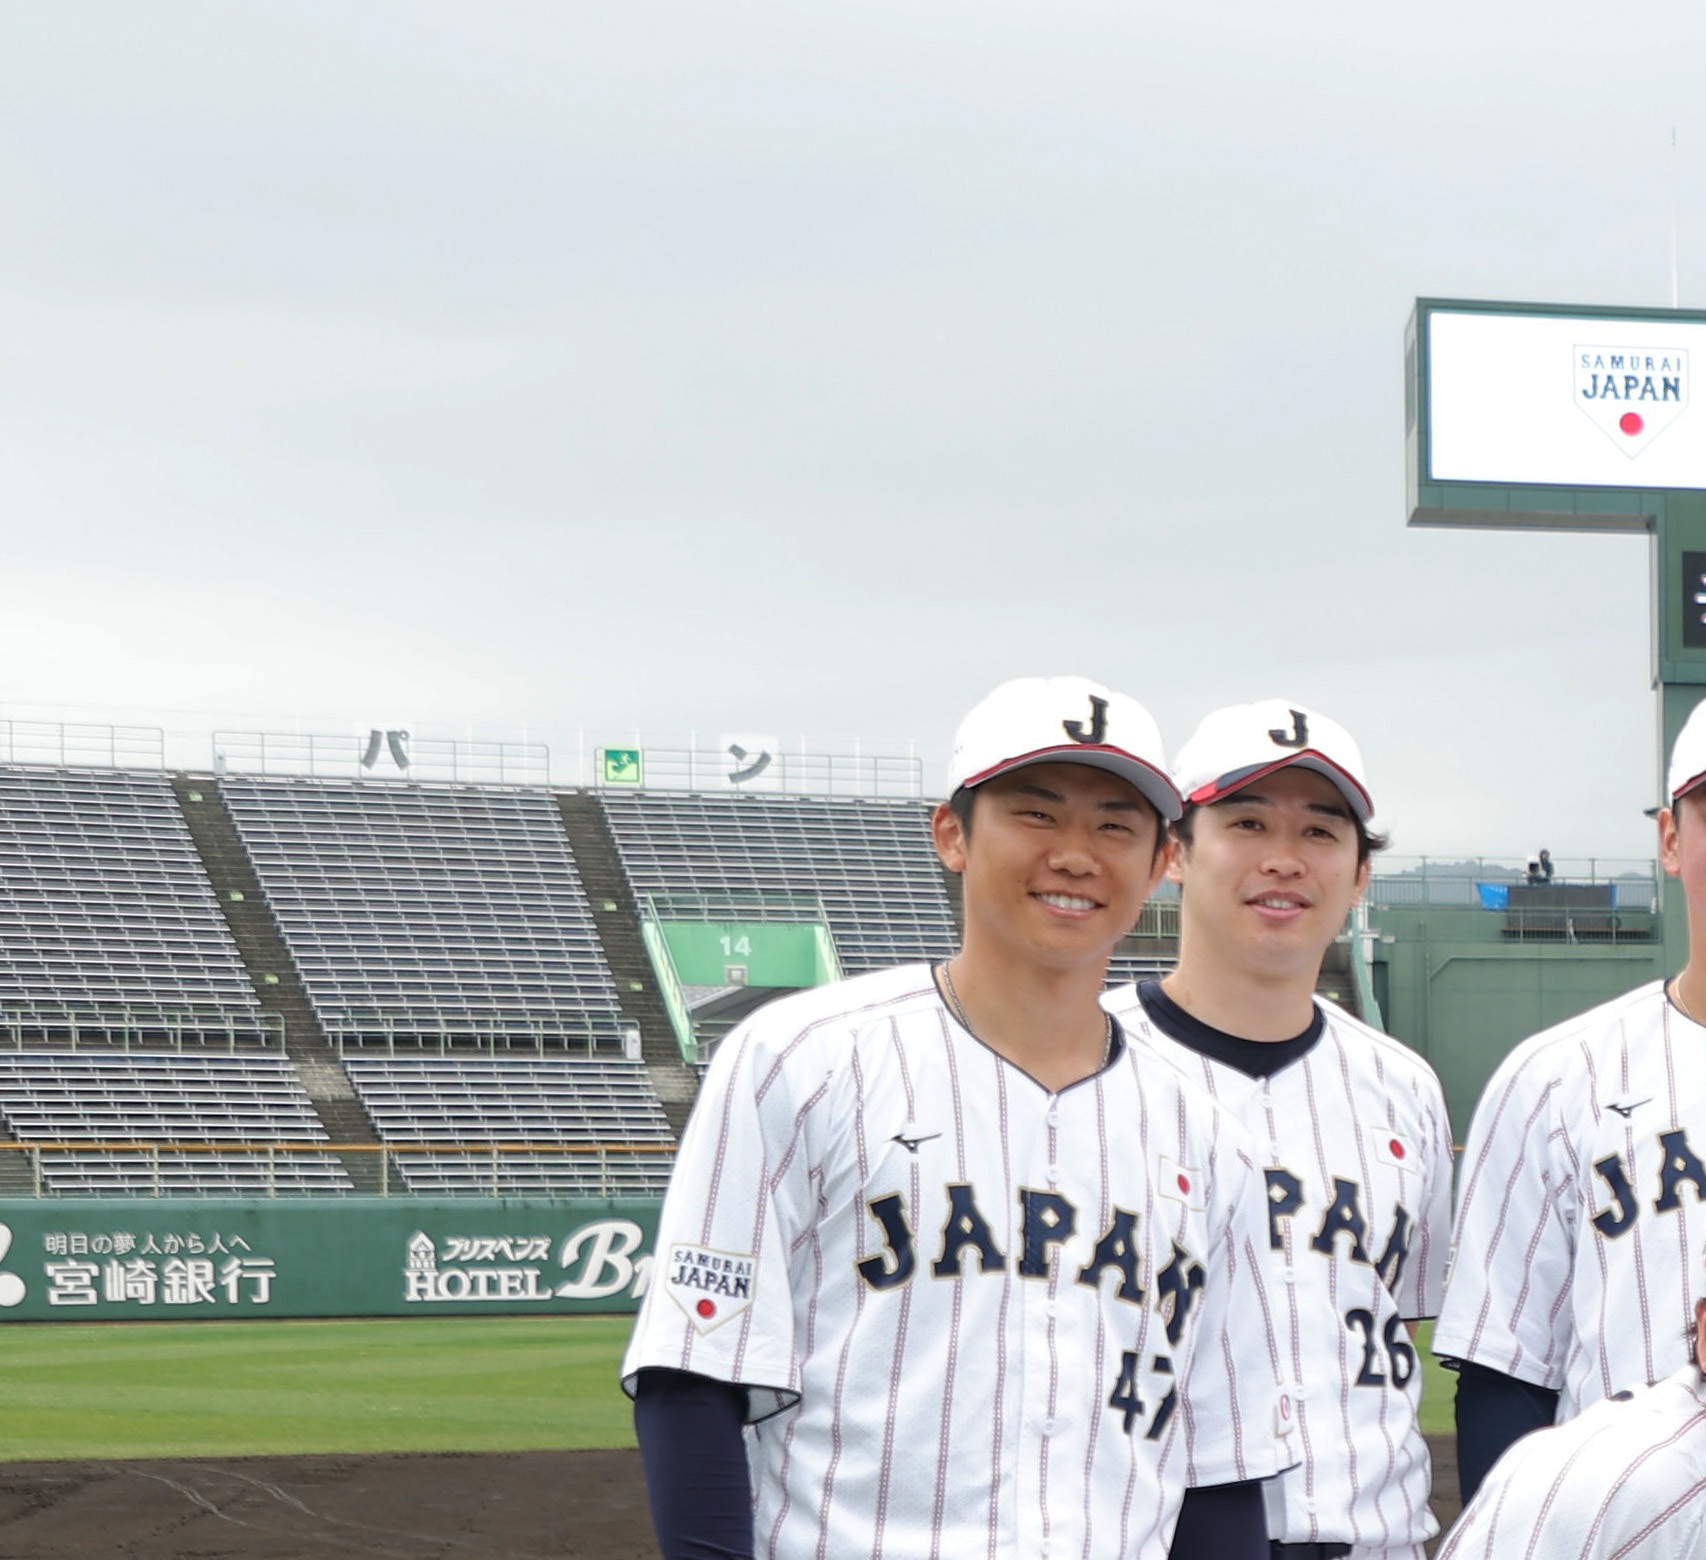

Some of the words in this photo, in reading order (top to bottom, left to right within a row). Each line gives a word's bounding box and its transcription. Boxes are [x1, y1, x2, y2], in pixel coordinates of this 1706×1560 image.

[1581, 354, 1681, 372] SAMURAI
[1582, 373, 1681, 402] JAPAN
[1063, 695, 1109, 745] J
[1268, 709, 1308, 748] J
[361, 729, 410, 770] パ
[728, 743, 772, 784] ン
[718, 935, 752, 957] 14
[1262, 1166, 1416, 1297] PAN
[44, 1257, 277, 1305] 宮崎銀行
[404, 1267, 553, 1301] HOTEL
[671, 1265, 751, 1300] JAPAN
[674, 1250, 752, 1277] SAMURAI
[854, 1182, 1207, 1349] JAPAN
[1345, 1308, 1415, 1391] 26
[1109, 1350, 1179, 1441] 47
